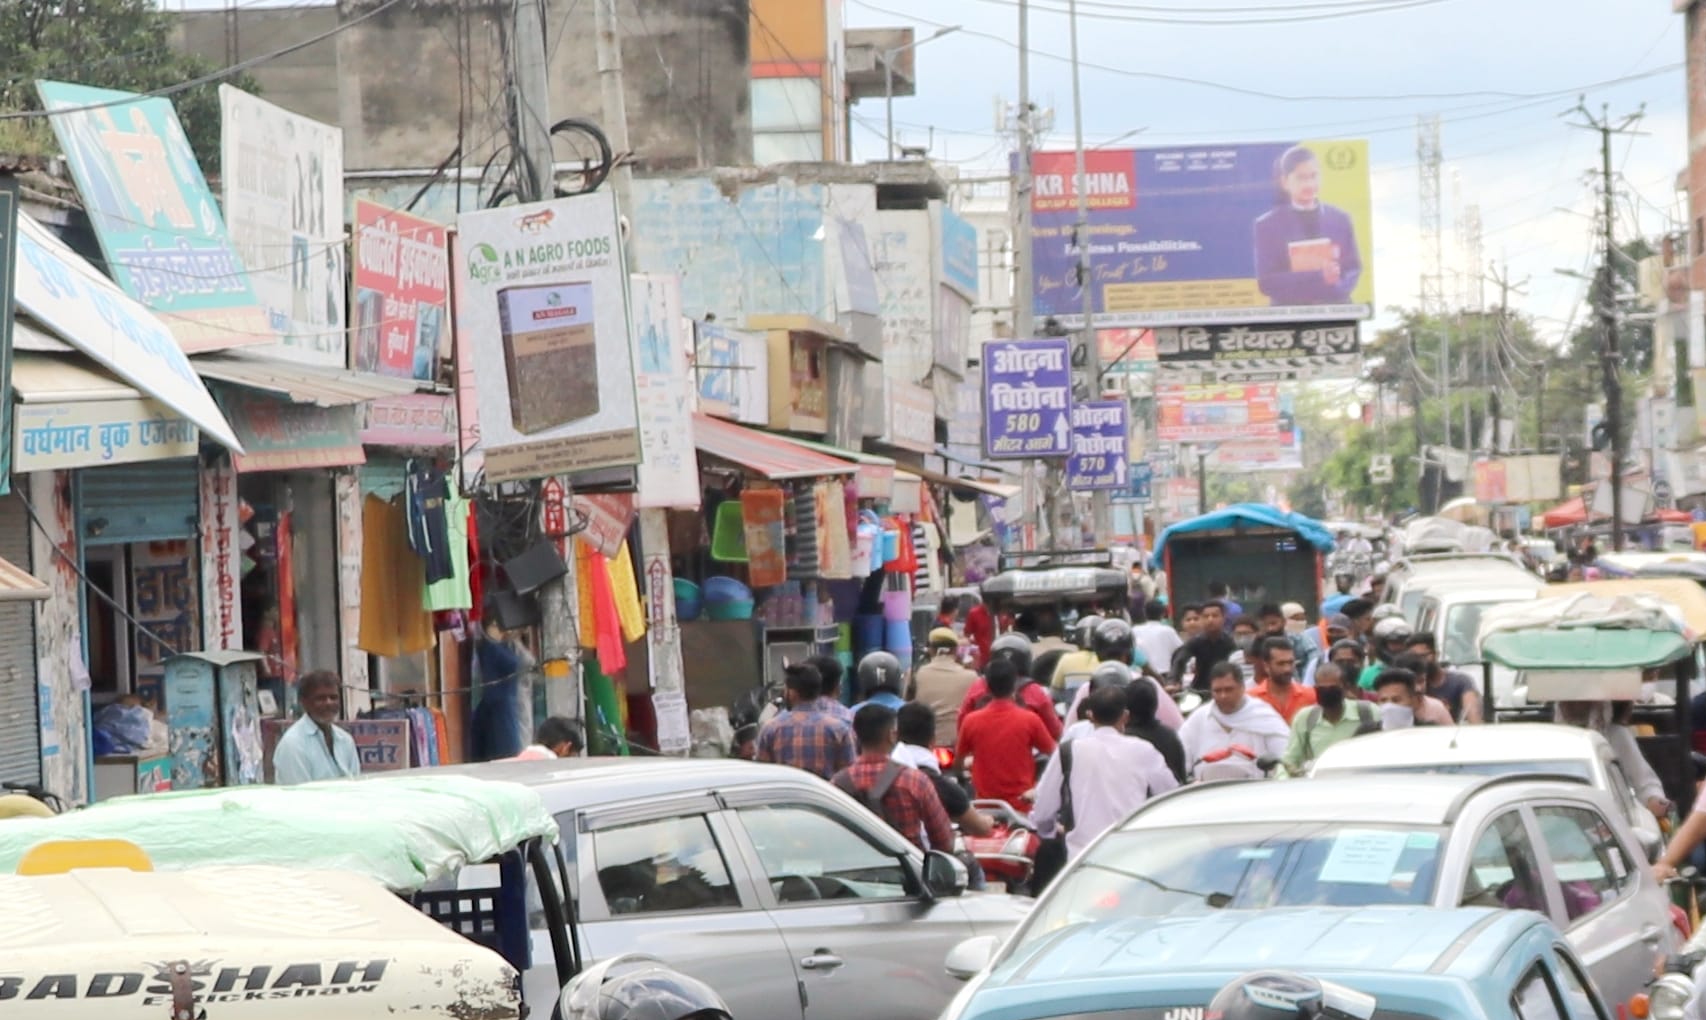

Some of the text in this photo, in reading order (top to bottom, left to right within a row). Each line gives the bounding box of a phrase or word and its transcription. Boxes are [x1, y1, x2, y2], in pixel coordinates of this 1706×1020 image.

[529, 243, 564, 265] AGRO
[567, 236, 611, 259] FOODS
[1180, 329, 1212, 350] दि
[1218, 327, 1295, 350] रॉयल
[993, 344, 1065, 377] ओढ़ना
[991, 381, 1067, 411] बिछौना
[1006, 413, 1041, 433] 580
[98, 422, 132, 459] बुक
[1080, 457, 1105, 471] 570
